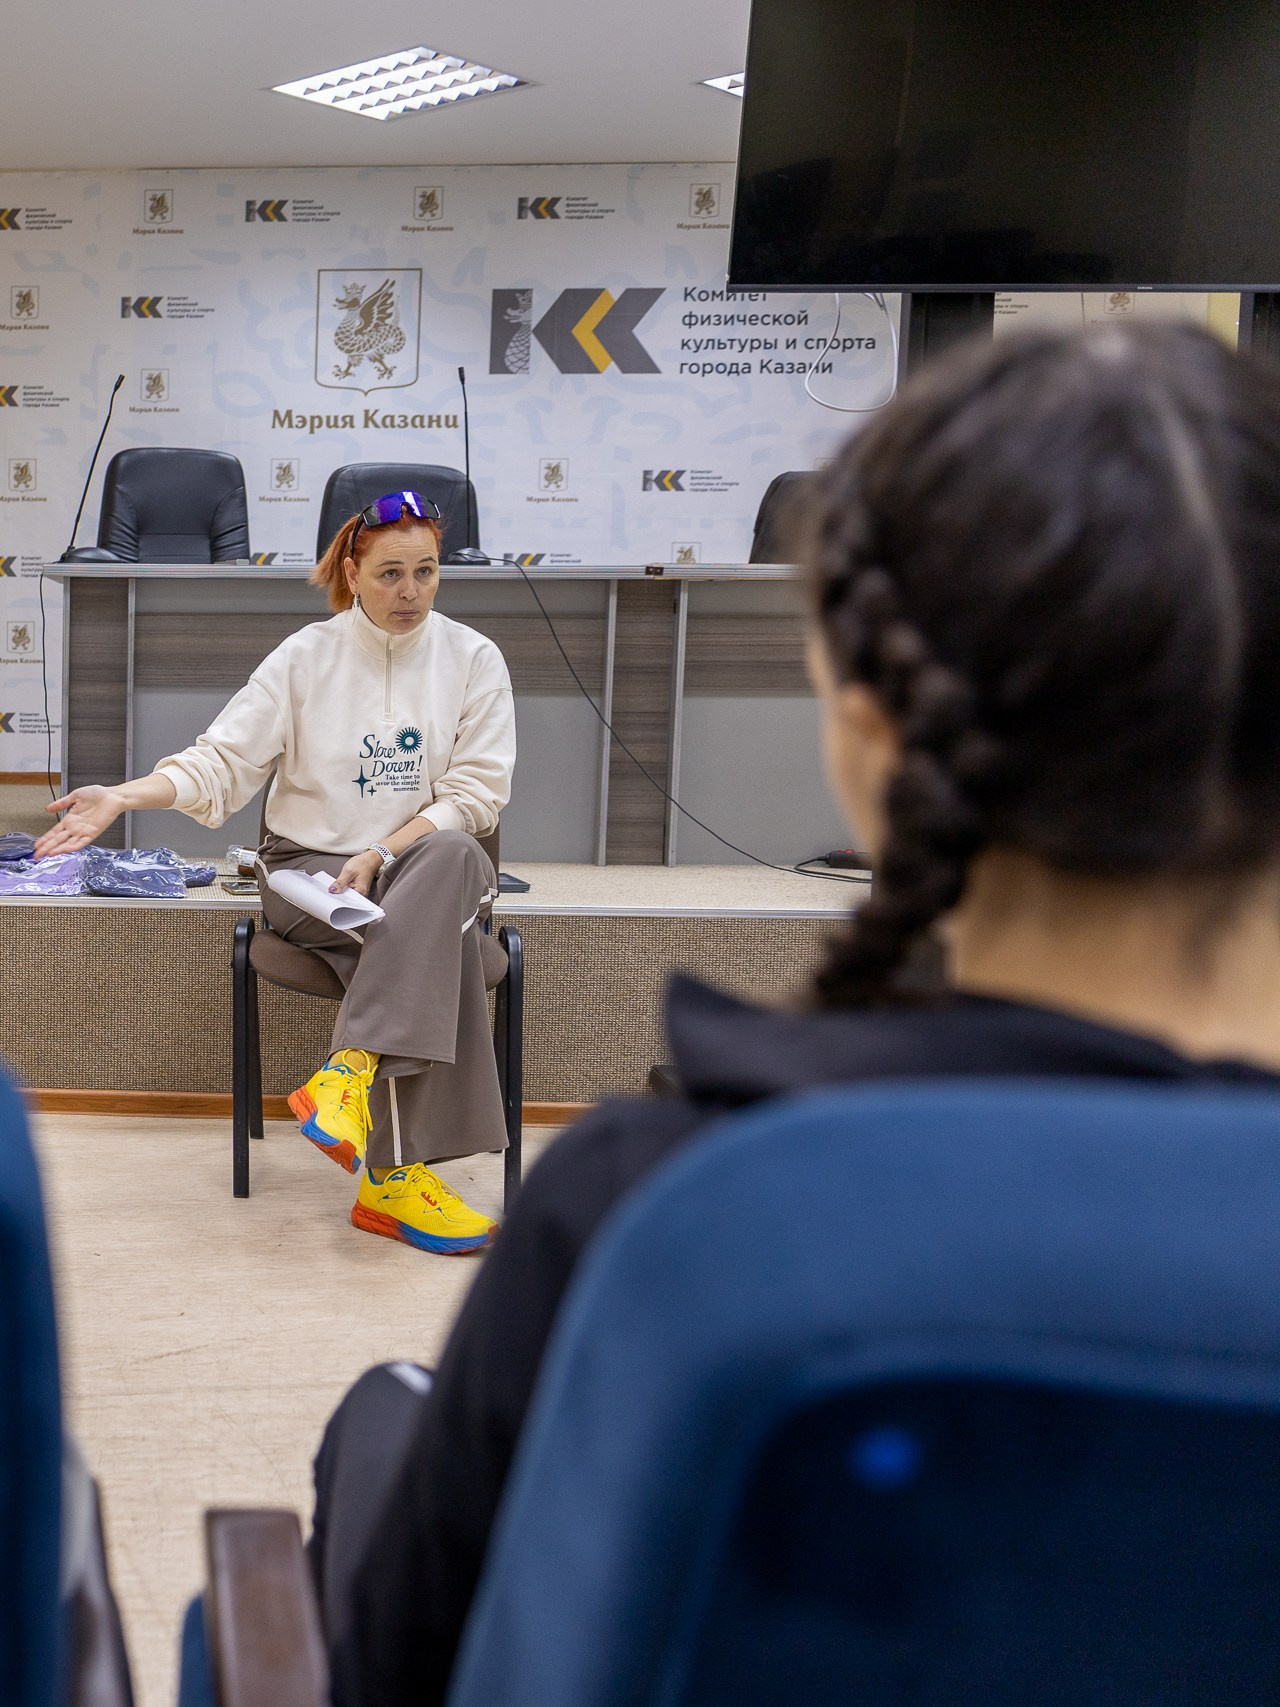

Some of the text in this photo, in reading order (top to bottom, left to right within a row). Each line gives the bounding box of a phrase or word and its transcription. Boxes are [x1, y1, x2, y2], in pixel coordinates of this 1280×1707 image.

[682, 310, 809, 329] физической
[680, 337, 876, 353] культуры и спорта
[679, 358, 833, 377] города Казани
[271, 409, 460, 434] Мэрия Казани
[359, 734, 396, 759] Slow
[370, 755, 423, 778] Down!
[401, 779, 420, 787] simple
